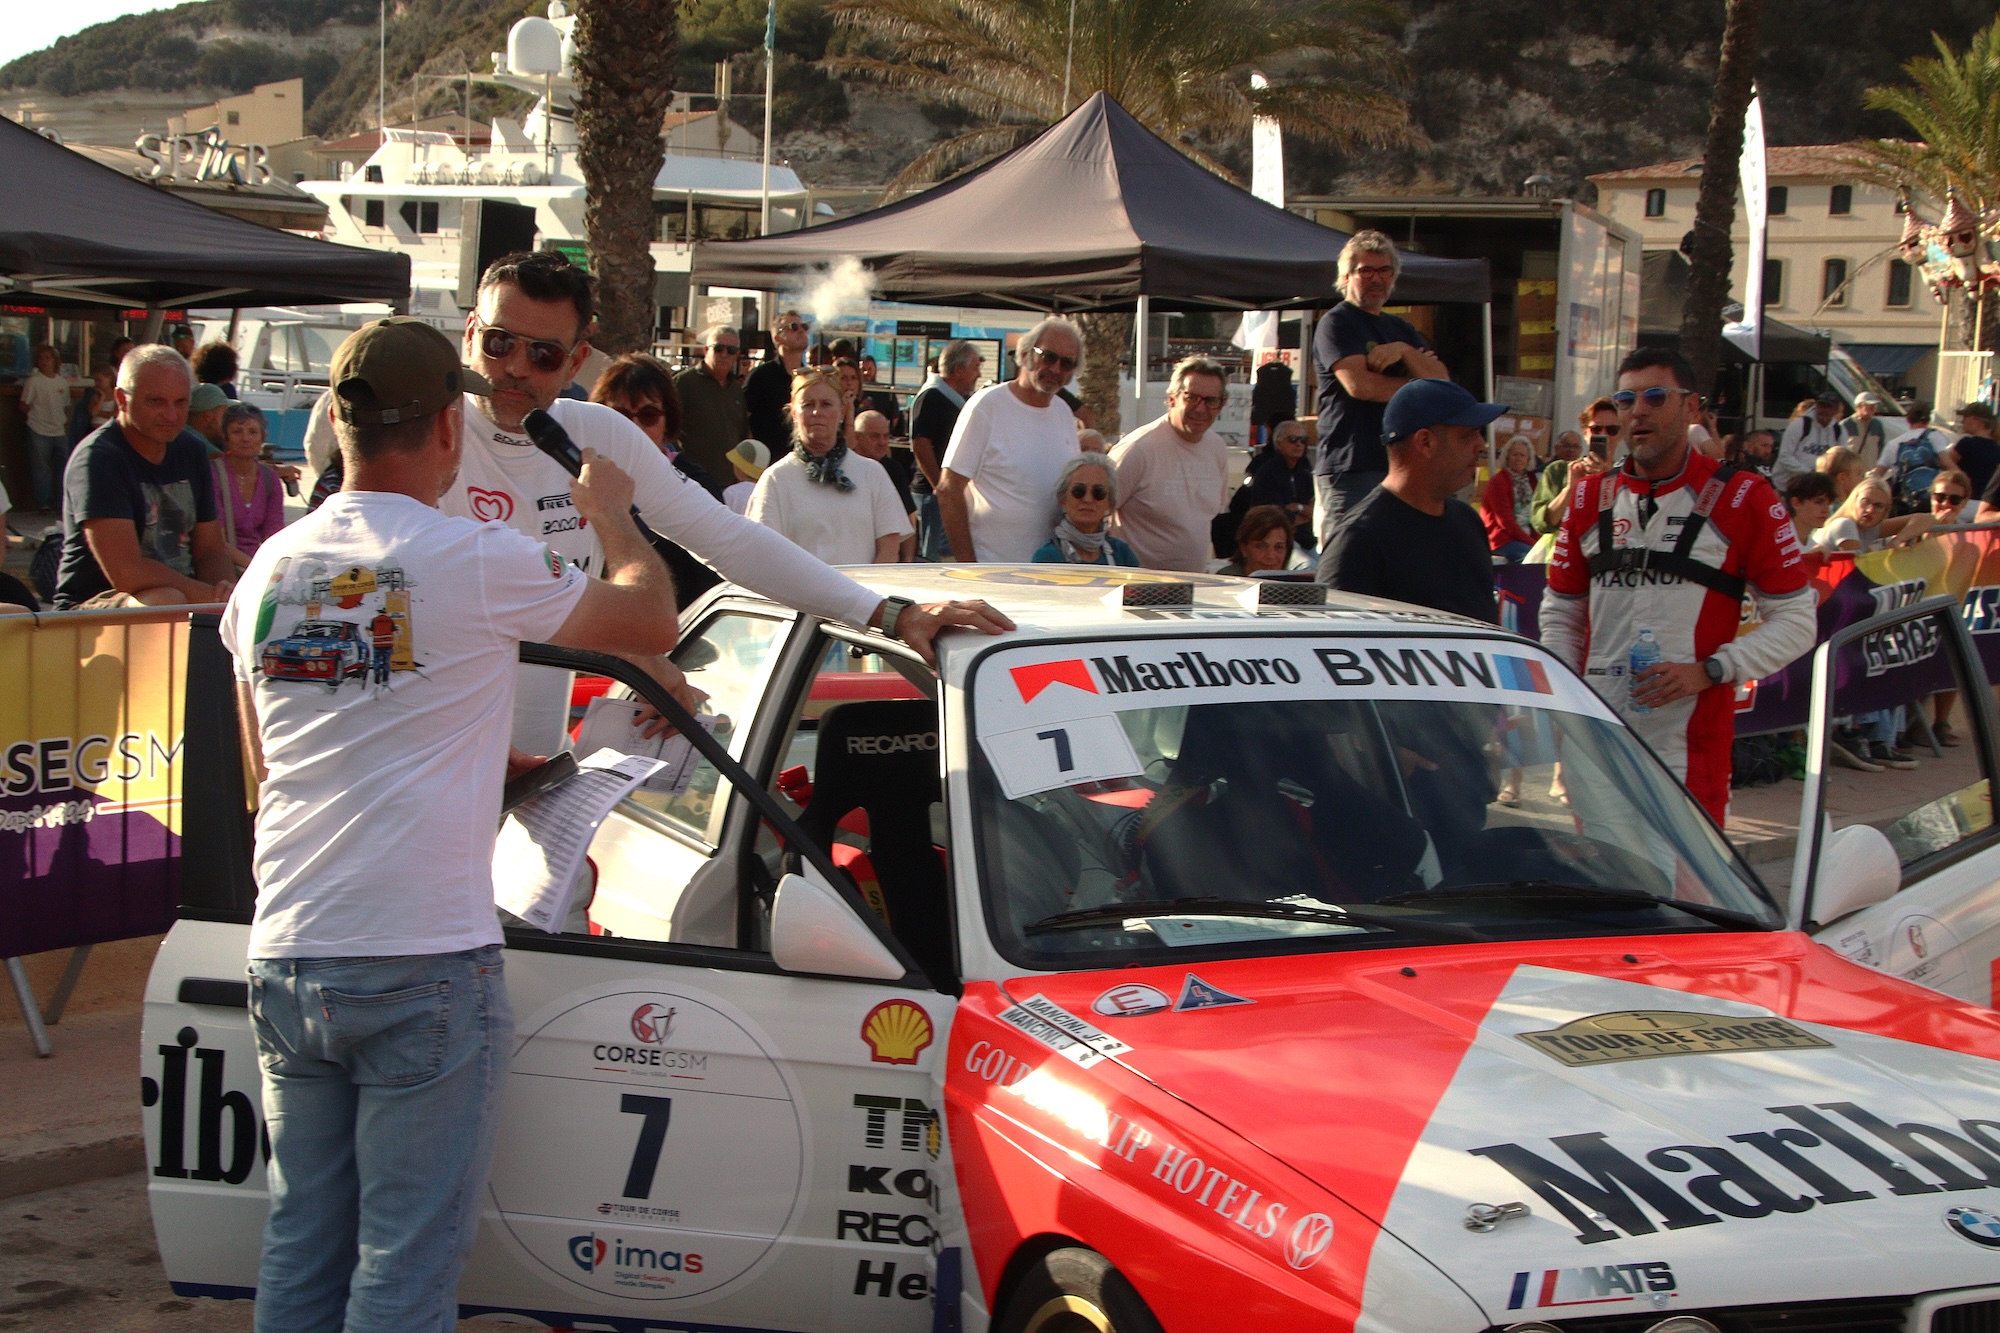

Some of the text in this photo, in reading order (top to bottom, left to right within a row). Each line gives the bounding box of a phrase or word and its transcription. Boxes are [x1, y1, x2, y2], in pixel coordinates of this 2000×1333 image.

[1091, 647, 1497, 694] Marlboro BMW
[847, 731, 938, 754] RECARO
[1036, 728, 1075, 773] 7
[1539, 1020, 1806, 1053] TOUR DE CORSE
[1634, 1014, 1661, 1028] 7
[593, 1044, 709, 1071] CORSEGSM
[620, 1093, 672, 1200] 7
[1151, 1142, 1289, 1239] HOTELS
[614, 1238, 704, 1274] imas
